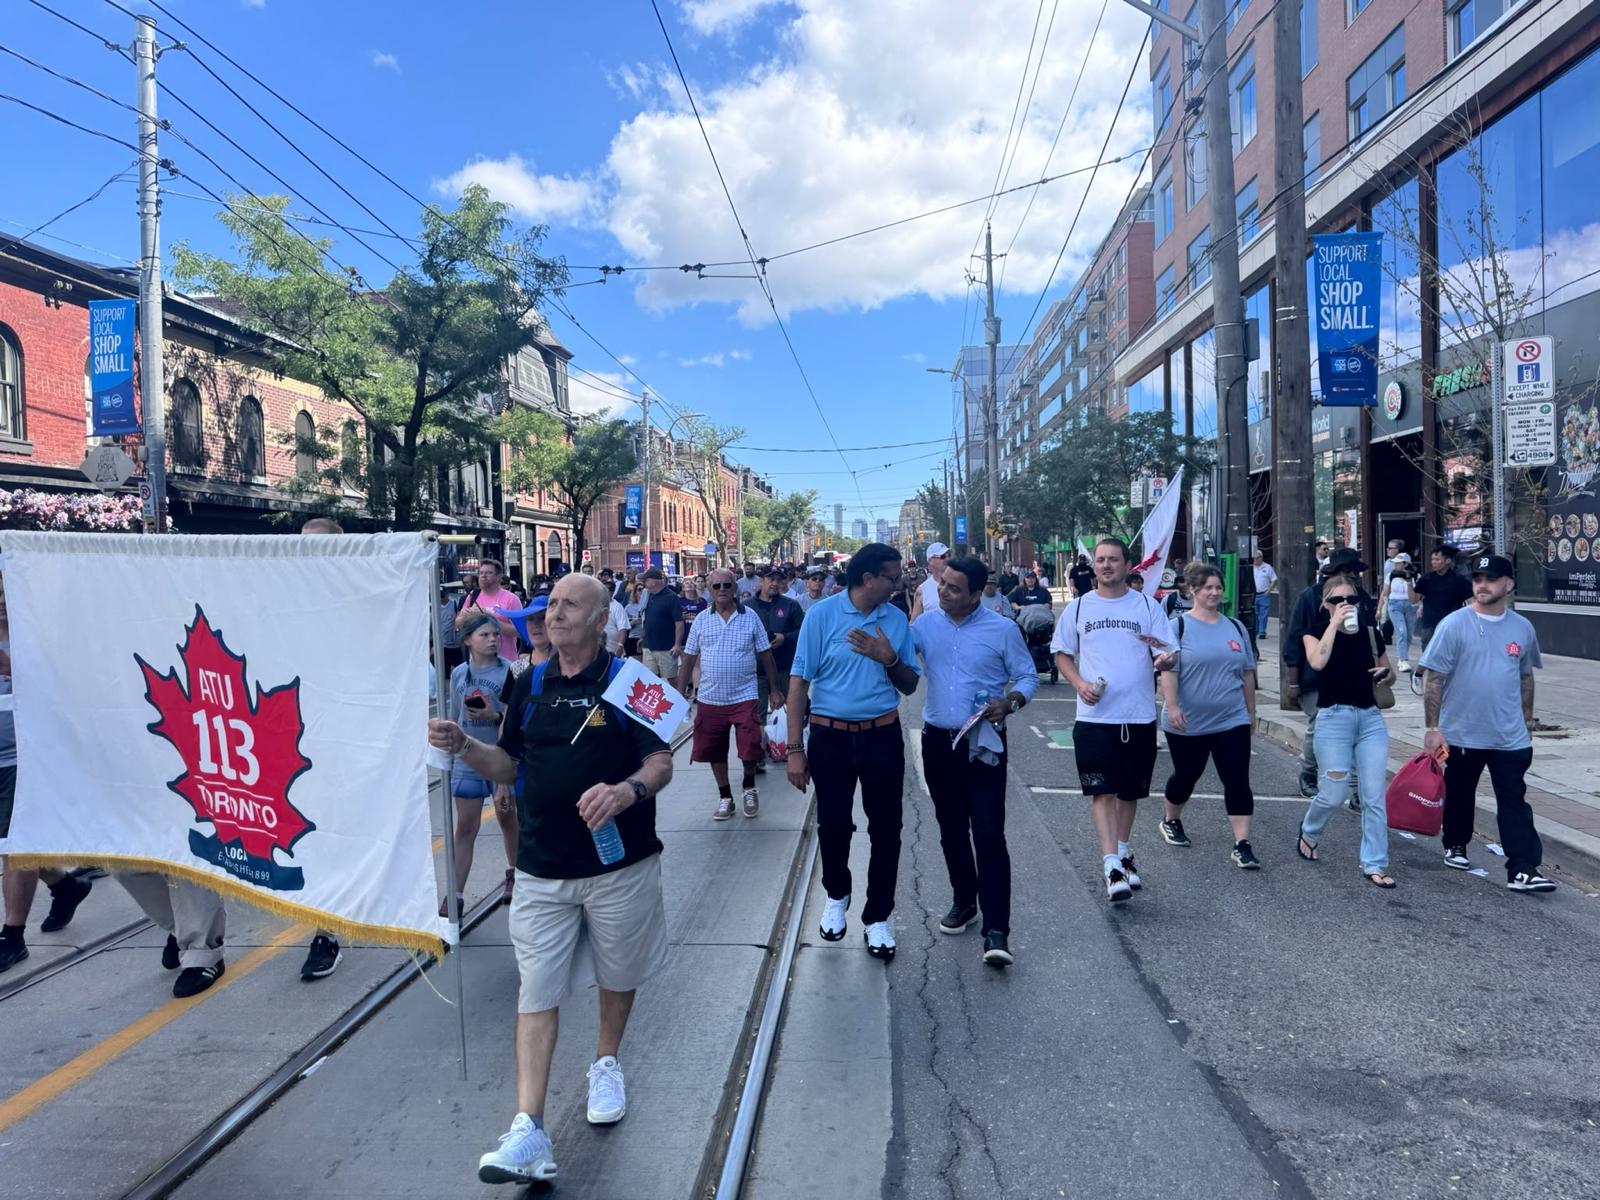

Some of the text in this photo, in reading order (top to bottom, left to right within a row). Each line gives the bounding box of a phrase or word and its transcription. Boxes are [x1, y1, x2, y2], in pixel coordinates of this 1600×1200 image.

[1318, 244, 1368, 263] SUPPORT
[1320, 281, 1363, 306] SHOP
[93, 307, 127, 322] SUPPORT
[94, 335, 122, 355] SHOP
[1508, 384, 1530, 392] EXCEPT
[1515, 390, 1544, 399] CHARGING
[1084, 617, 1142, 634] Scarborough
[199, 667, 235, 711] ATU
[648, 688, 662, 699] ATU
[638, 691, 660, 709] 113
[192, 708, 260, 786] 113
